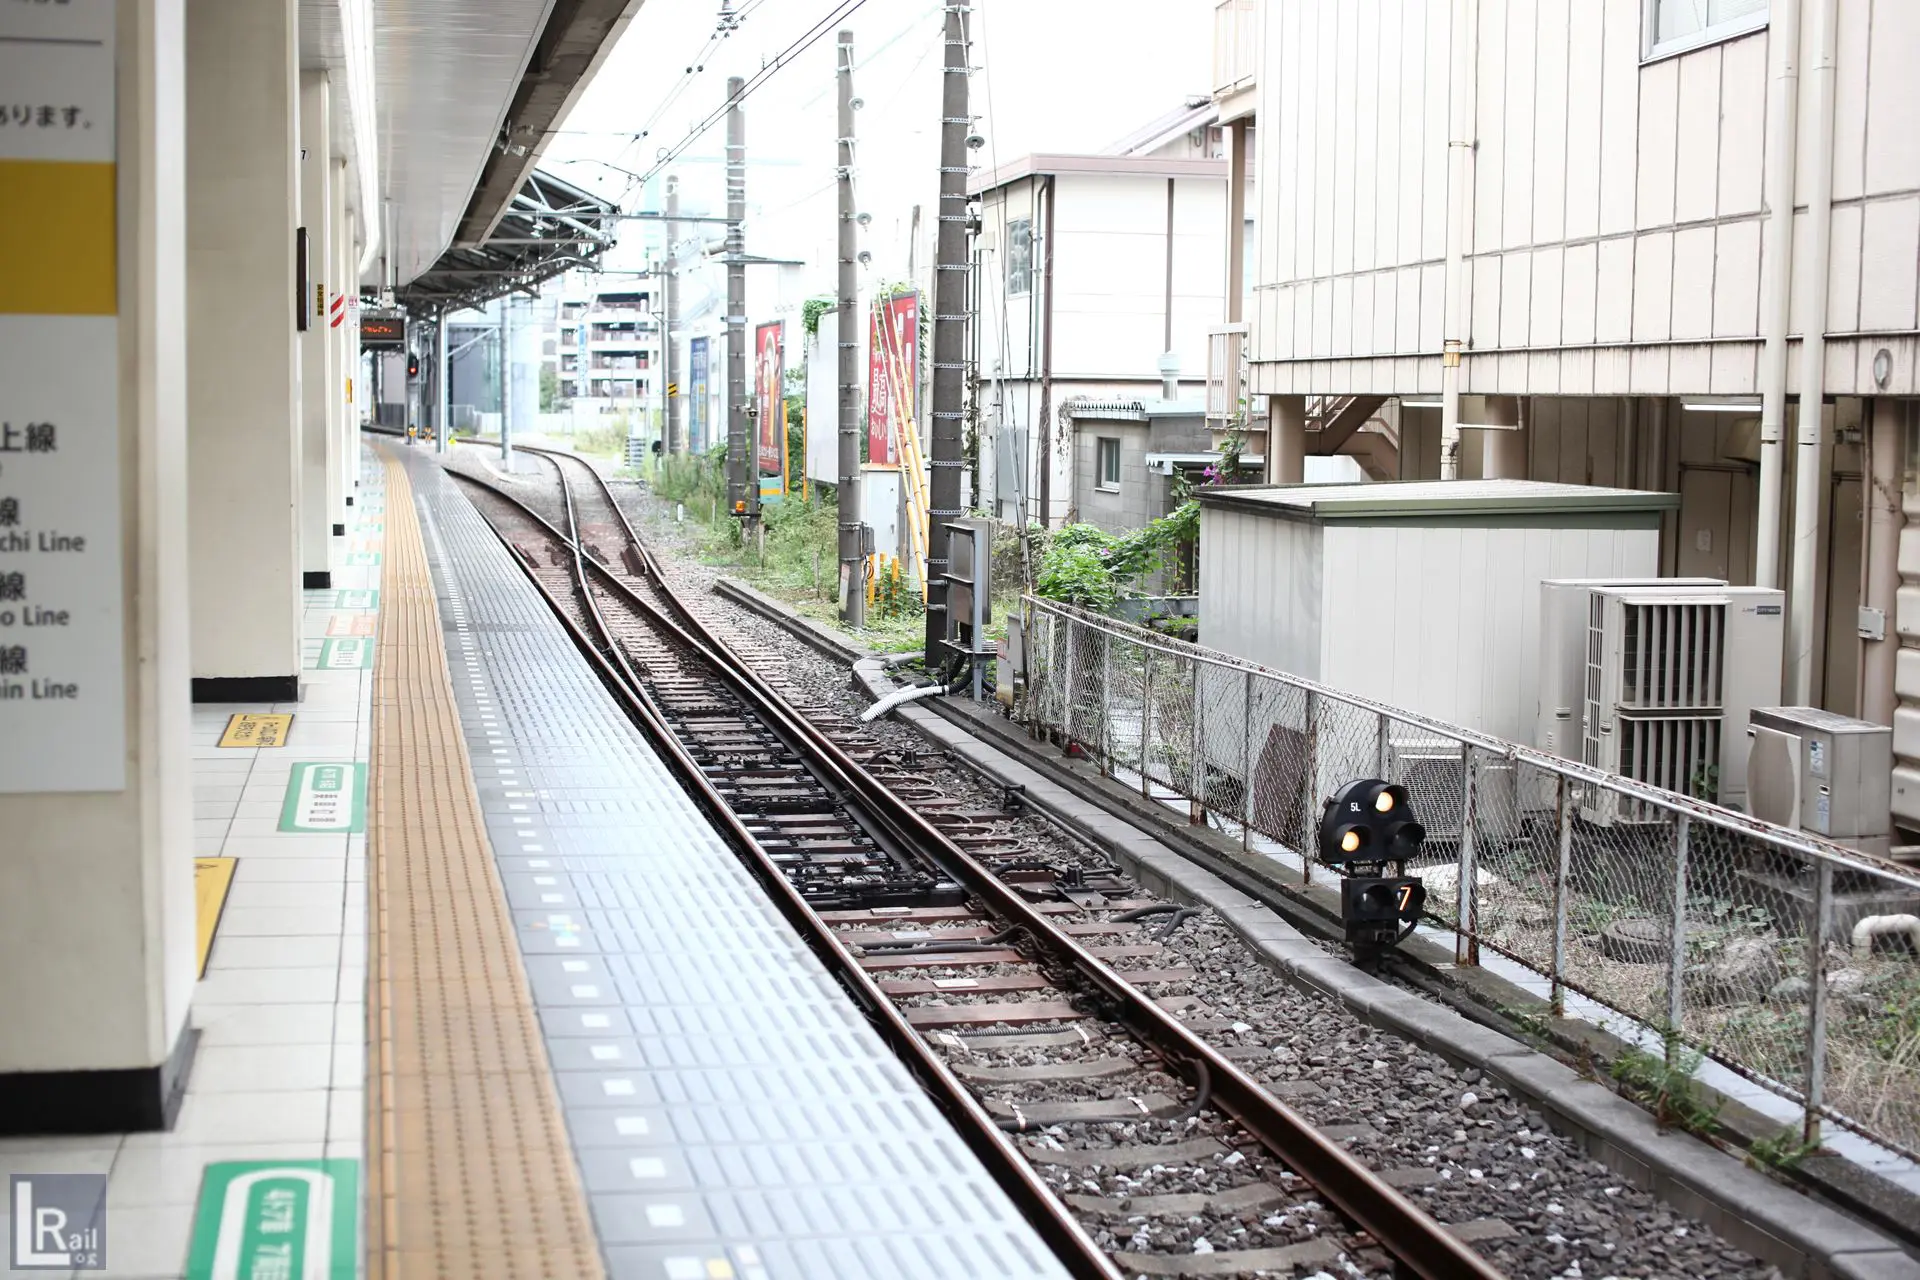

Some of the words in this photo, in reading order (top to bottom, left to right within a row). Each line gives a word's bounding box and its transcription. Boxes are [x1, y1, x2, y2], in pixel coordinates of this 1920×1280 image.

[38, 530, 86, 553] Line
[23, 605, 70, 627] Line
[0, 644, 28, 675] 線
[0, 678, 25, 699] in
[31, 678, 78, 700] Line
[1350, 802, 1361, 812] 5L
[1399, 886, 1412, 911] 7
